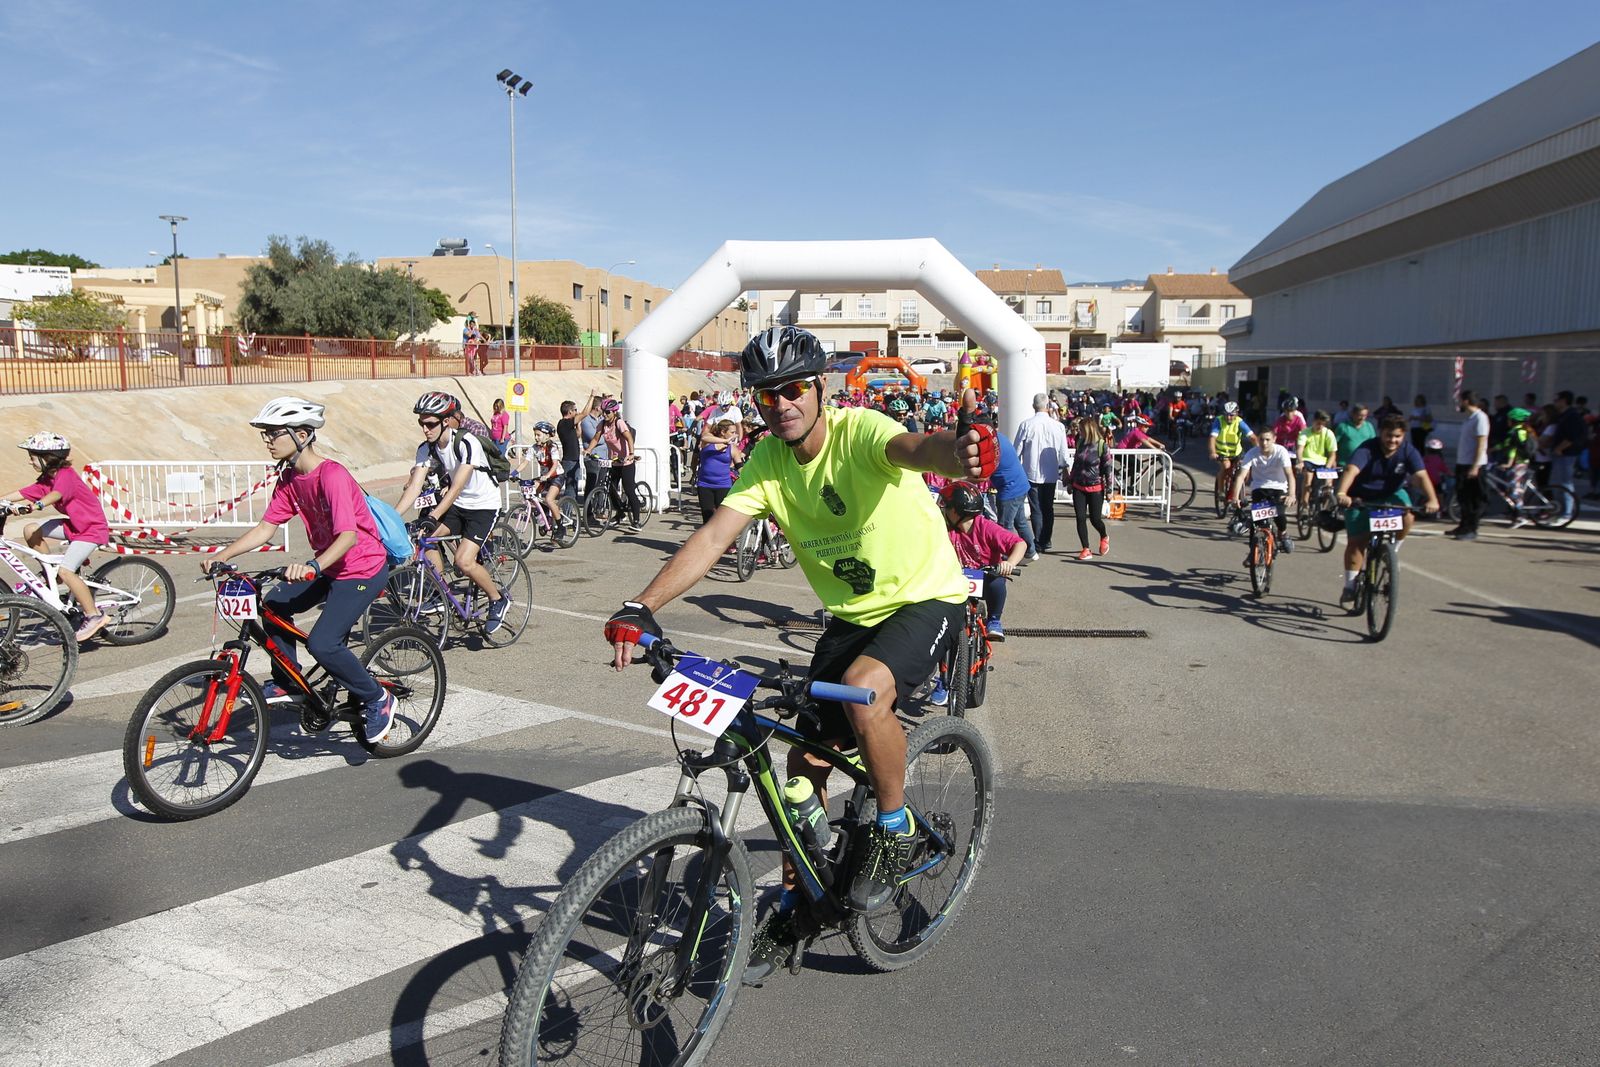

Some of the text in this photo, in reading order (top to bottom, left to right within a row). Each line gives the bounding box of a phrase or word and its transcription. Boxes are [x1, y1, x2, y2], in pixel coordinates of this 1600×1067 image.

[1254, 508, 1275, 519] 496
[1373, 518, 1398, 529] 445
[662, 682, 726, 726] 481
